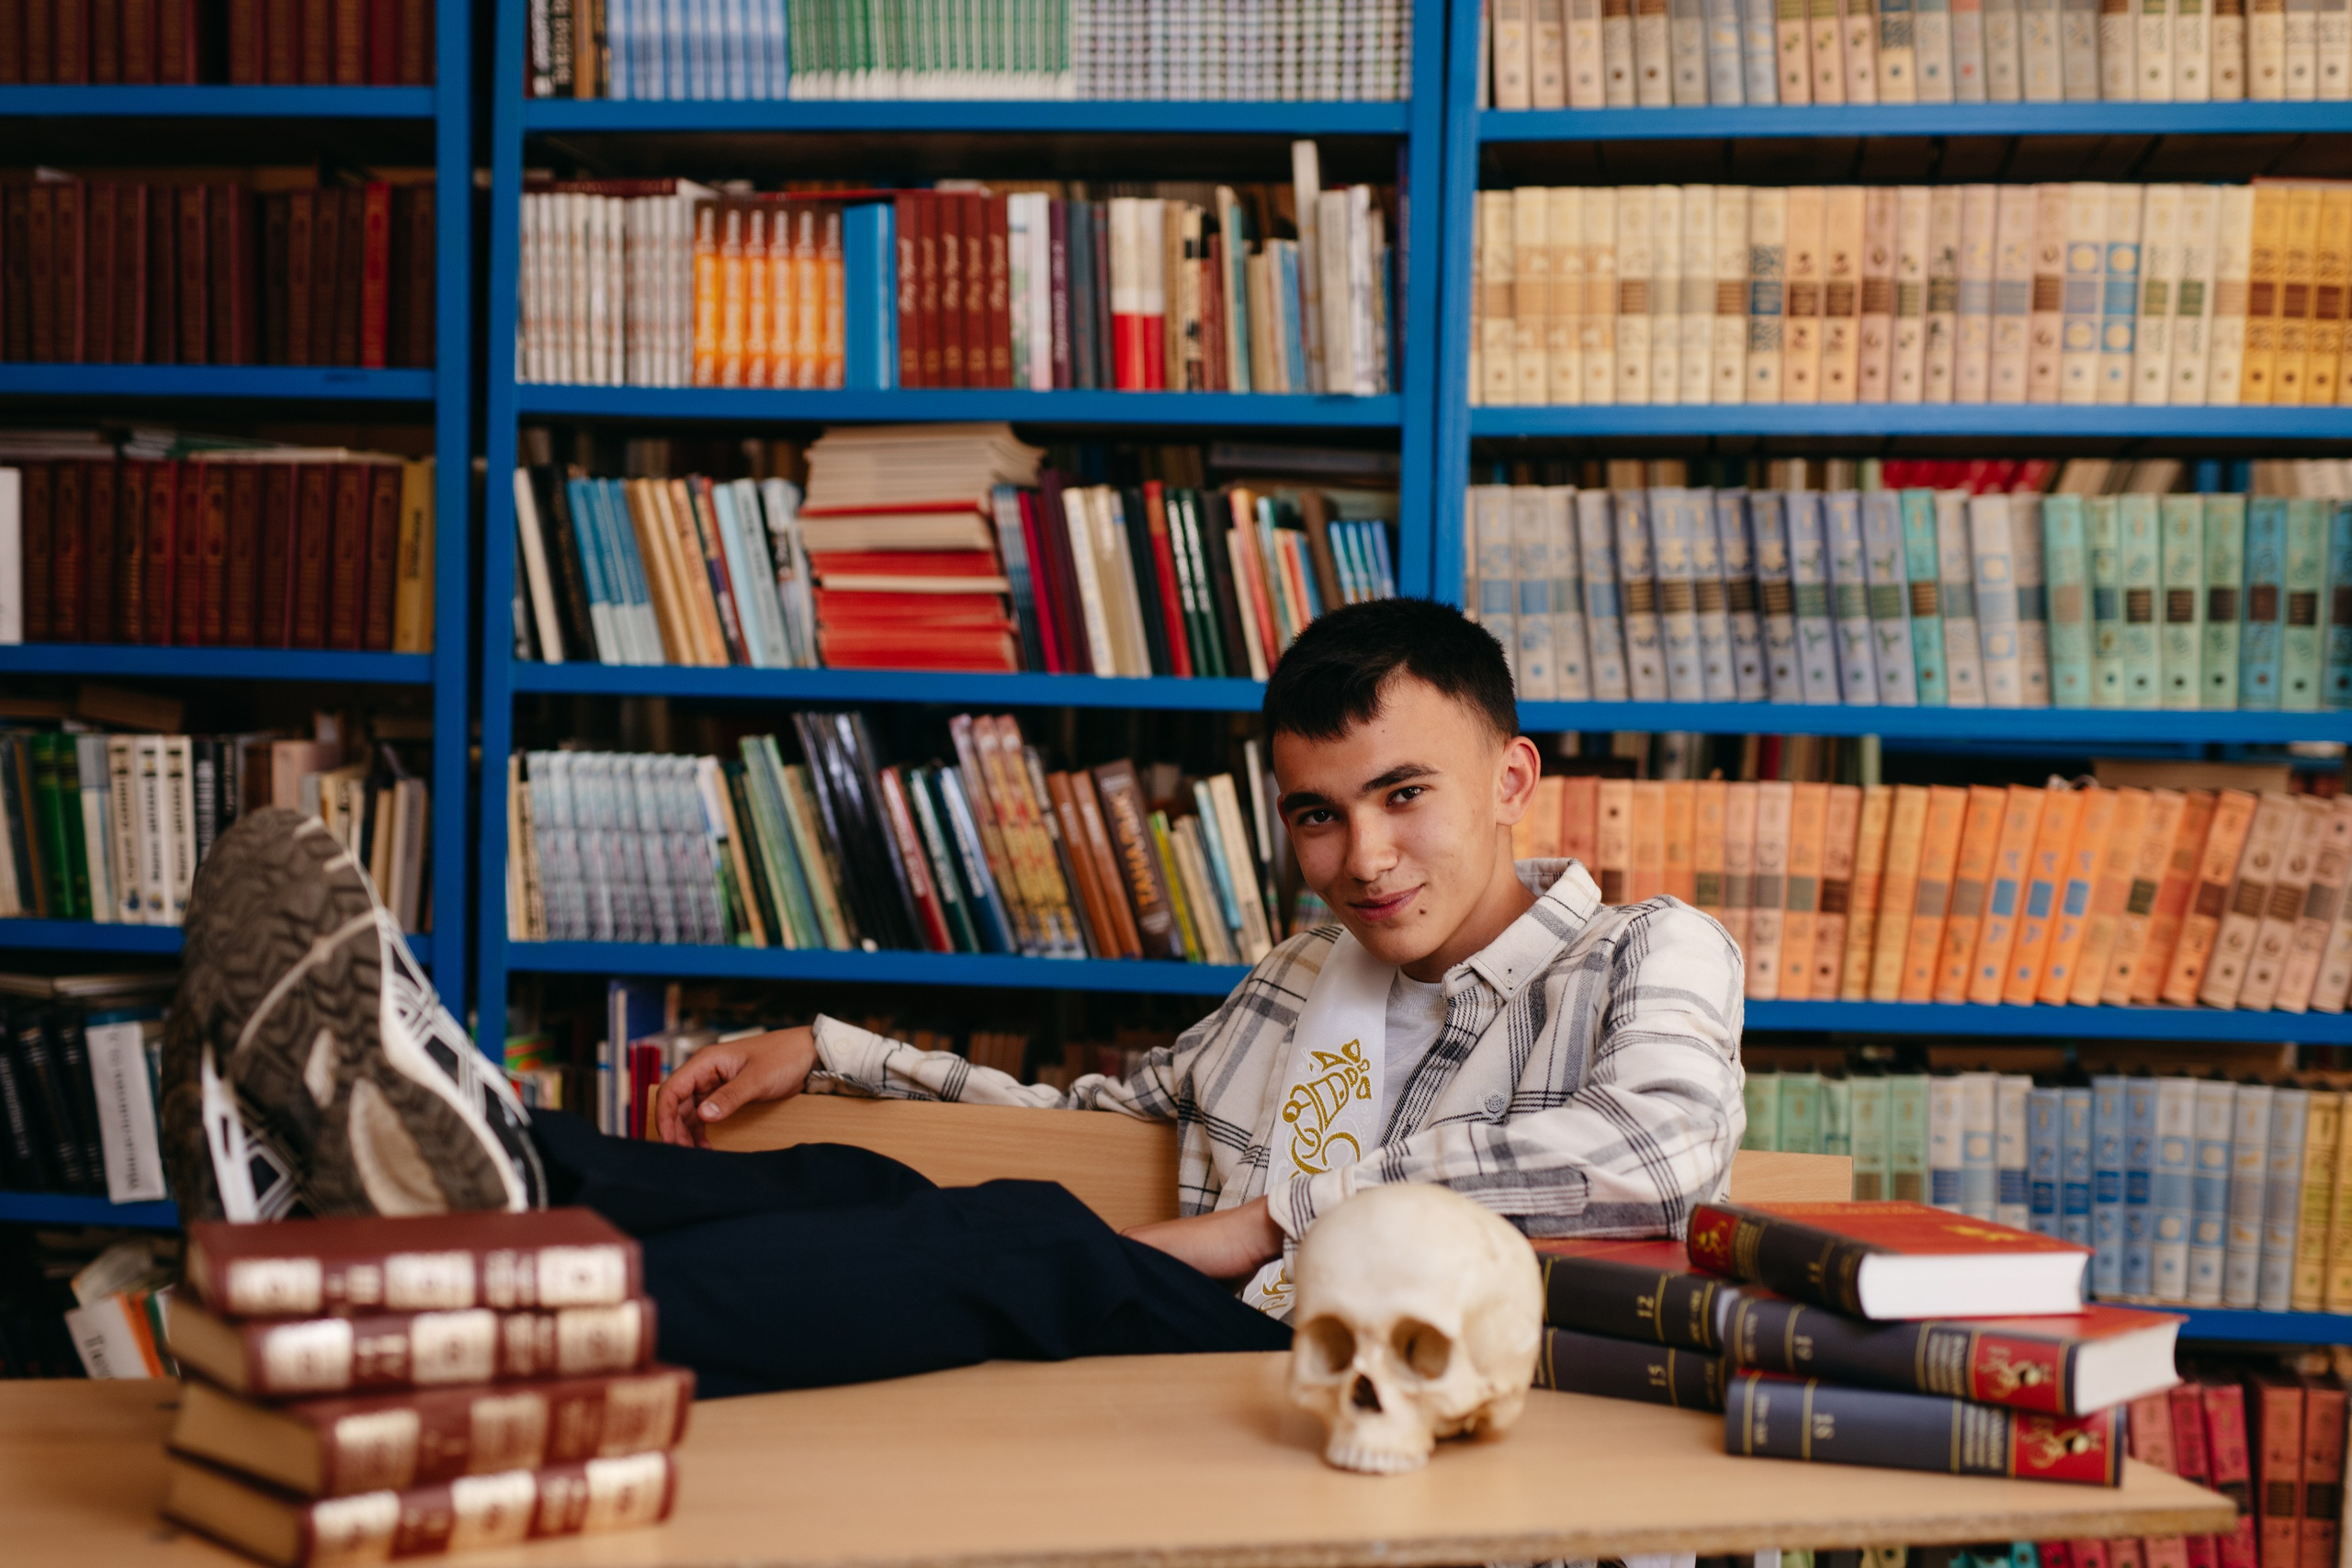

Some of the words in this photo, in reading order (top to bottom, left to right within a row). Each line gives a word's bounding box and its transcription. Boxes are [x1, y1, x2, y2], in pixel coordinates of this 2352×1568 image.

[1635, 1294, 1656, 1319] 12
[1646, 1362, 1668, 1387] 15
[1812, 1413, 1837, 1440] 18
